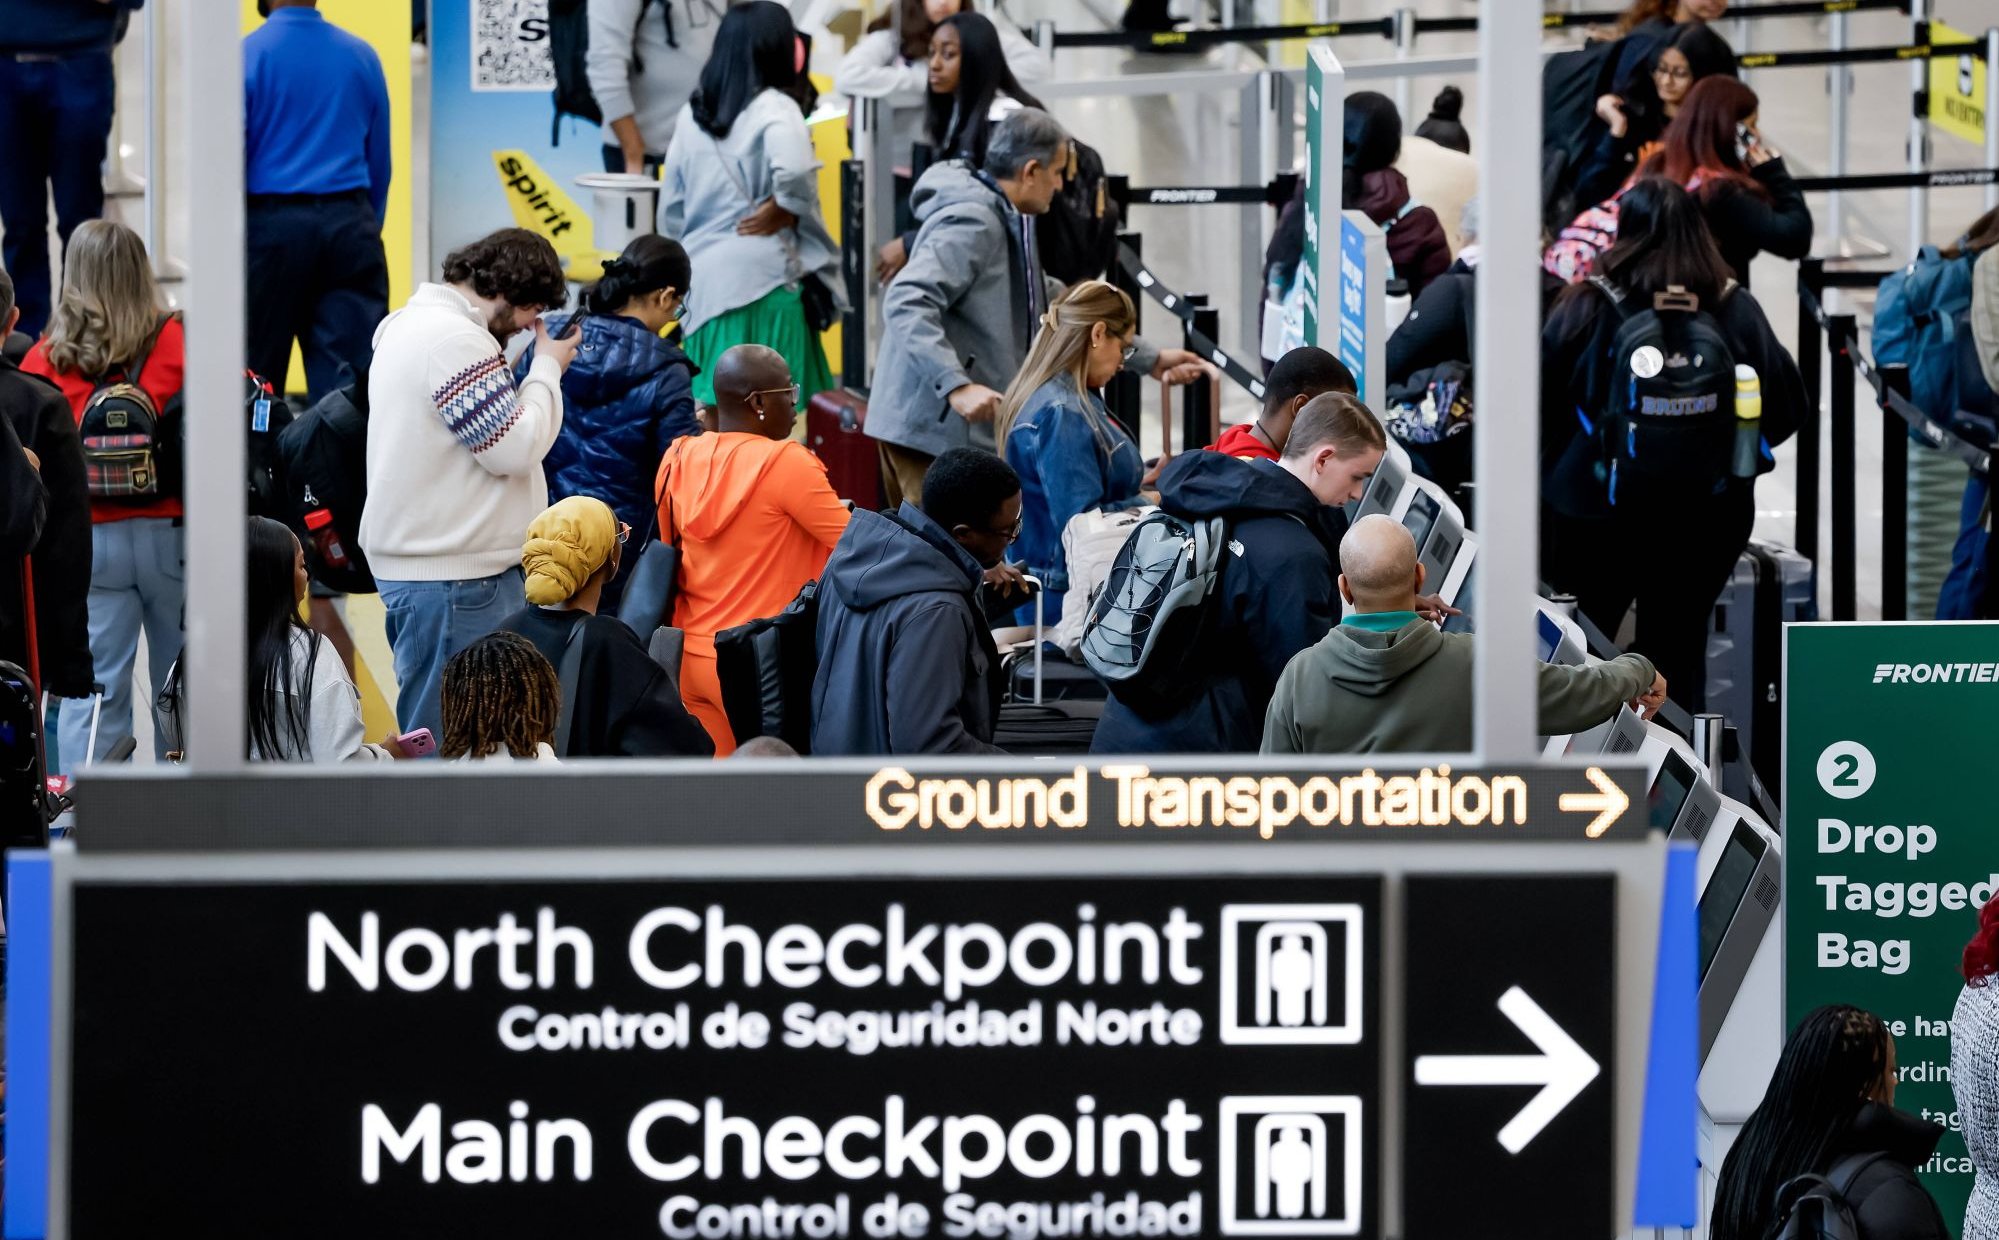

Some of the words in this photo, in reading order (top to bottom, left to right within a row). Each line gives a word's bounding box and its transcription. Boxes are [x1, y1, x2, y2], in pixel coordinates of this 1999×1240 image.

[500, 157, 571, 237] spirit
[1150, 189, 1217, 203] FRONTIER
[1641, 393, 1718, 416] BRUINS
[1832, 753, 1859, 787] 2
[865, 765, 1089, 832] Ground
[1101, 764, 1527, 839] Transportation
[1818, 818, 1938, 861] Drop
[1816, 873, 1999, 918] Tagged
[306, 905, 595, 993] North
[627, 902, 1204, 1002] Checkpoint
[1817, 932, 1911, 975] Bag
[497, 1002, 690, 1052] Control
[702, 1002, 771, 1050] de
[782, 1000, 1043, 1056] Seguridad
[1056, 1001, 1203, 1047] Norte
[360, 1099, 594, 1186] Main
[627, 1094, 1203, 1193] Checkpoint
[658, 1193, 850, 1240] Control
[862, 1193, 930, 1240] de
[942, 1190, 1203, 1240] Seguridad
